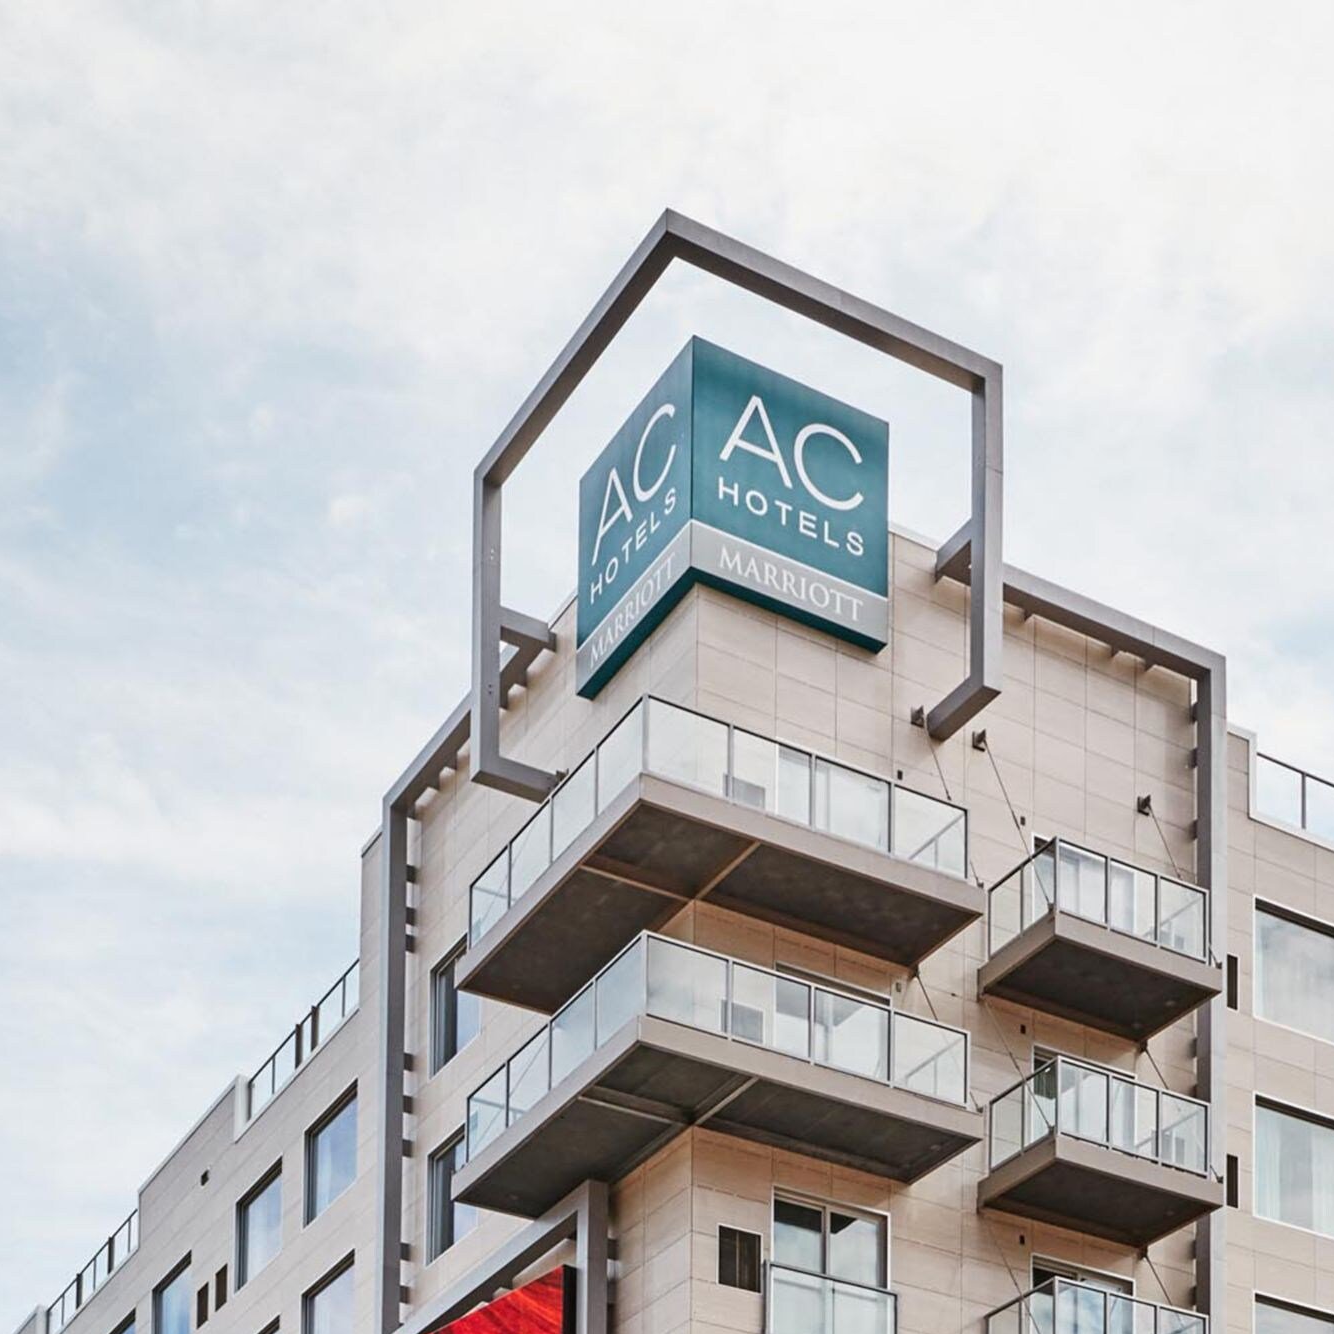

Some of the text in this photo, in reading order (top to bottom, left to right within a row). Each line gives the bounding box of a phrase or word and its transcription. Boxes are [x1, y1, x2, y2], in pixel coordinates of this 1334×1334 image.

[591, 403, 677, 566] AC
[719, 394, 863, 511] AC
[590, 487, 677, 605] HOTELS
[718, 477, 864, 556] HOTELS
[589, 553, 677, 669] MARRIOTT
[719, 545, 864, 621] MARRIOTT
